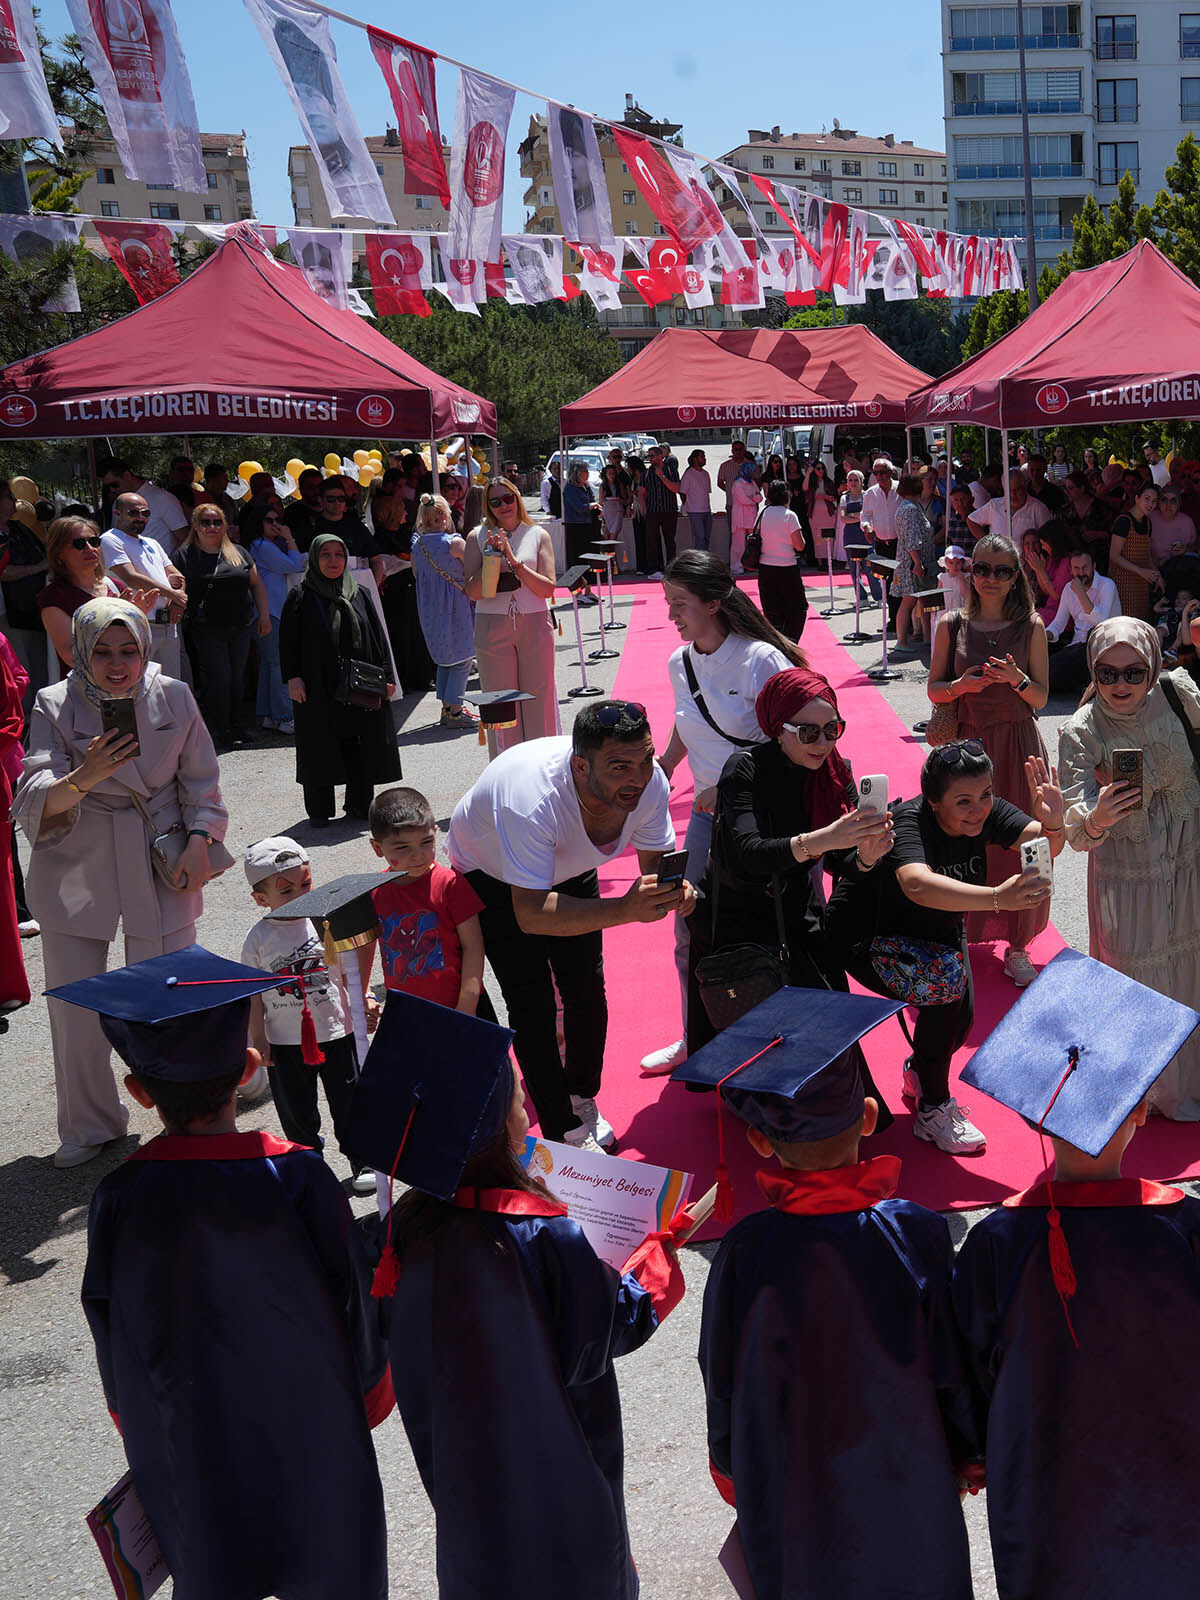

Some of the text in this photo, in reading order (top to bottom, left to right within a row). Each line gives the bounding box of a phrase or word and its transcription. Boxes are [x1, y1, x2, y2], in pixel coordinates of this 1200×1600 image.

[216, 393, 337, 421] BELEDİYESİ
[789, 402, 858, 418] BELEDİYESİ
[558, 1165, 613, 1188] Mezuniyet
[615, 1178, 655, 1197] Belgesi
